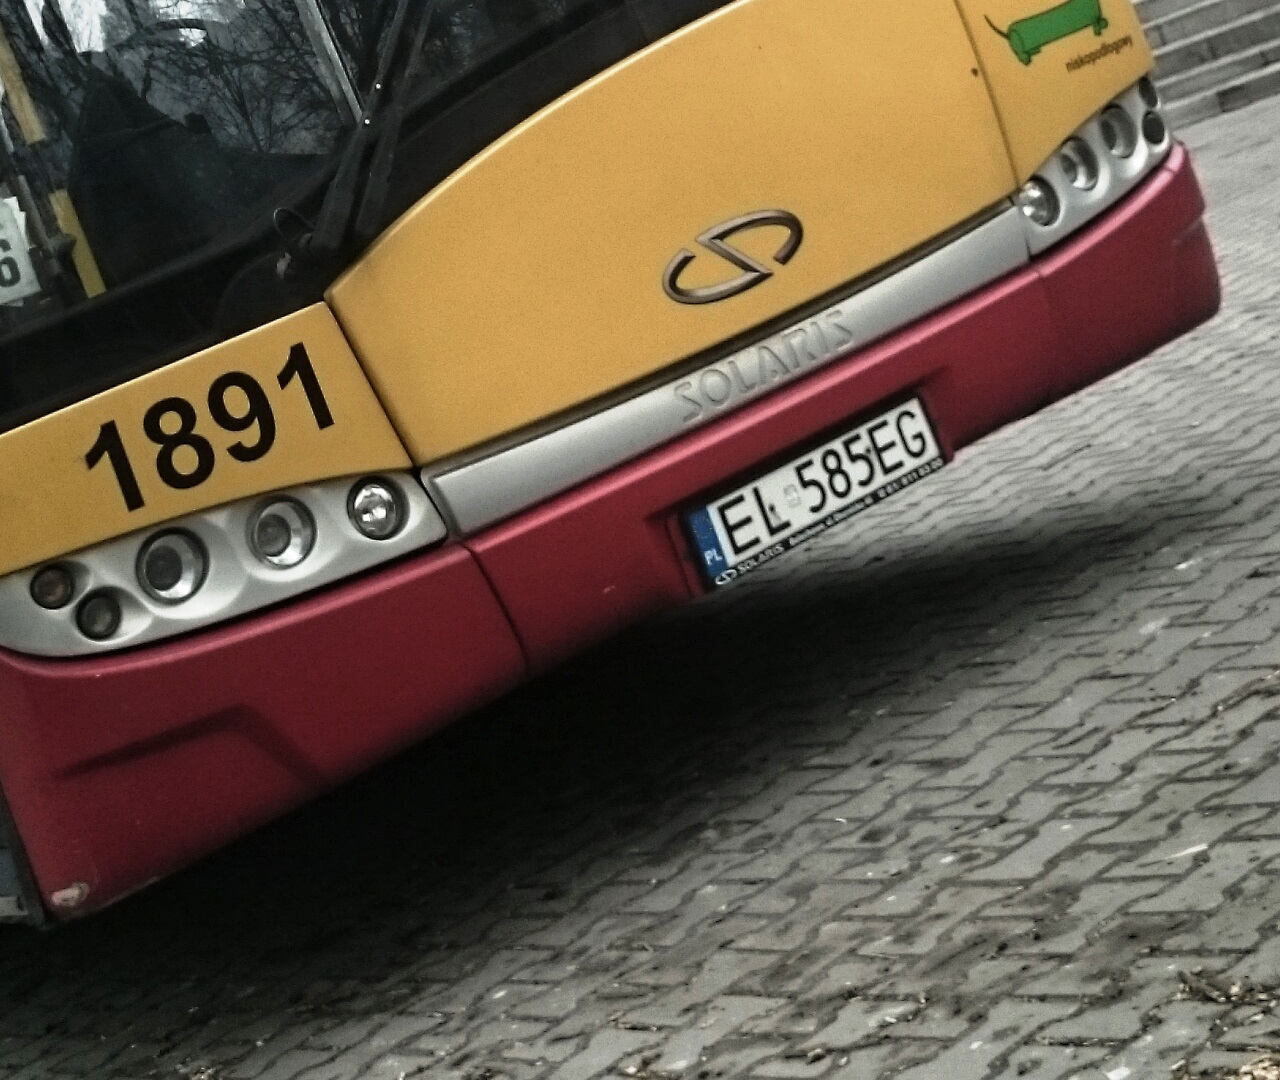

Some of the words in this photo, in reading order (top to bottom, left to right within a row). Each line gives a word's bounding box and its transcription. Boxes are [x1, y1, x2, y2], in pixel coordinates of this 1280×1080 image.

[84, 342, 336, 513] 1891
[673, 309, 855, 423] SOLARIS
[718, 486, 792, 556] EL
[795, 410, 927, 514] 585EG
[703, 547, 724, 566] PL
